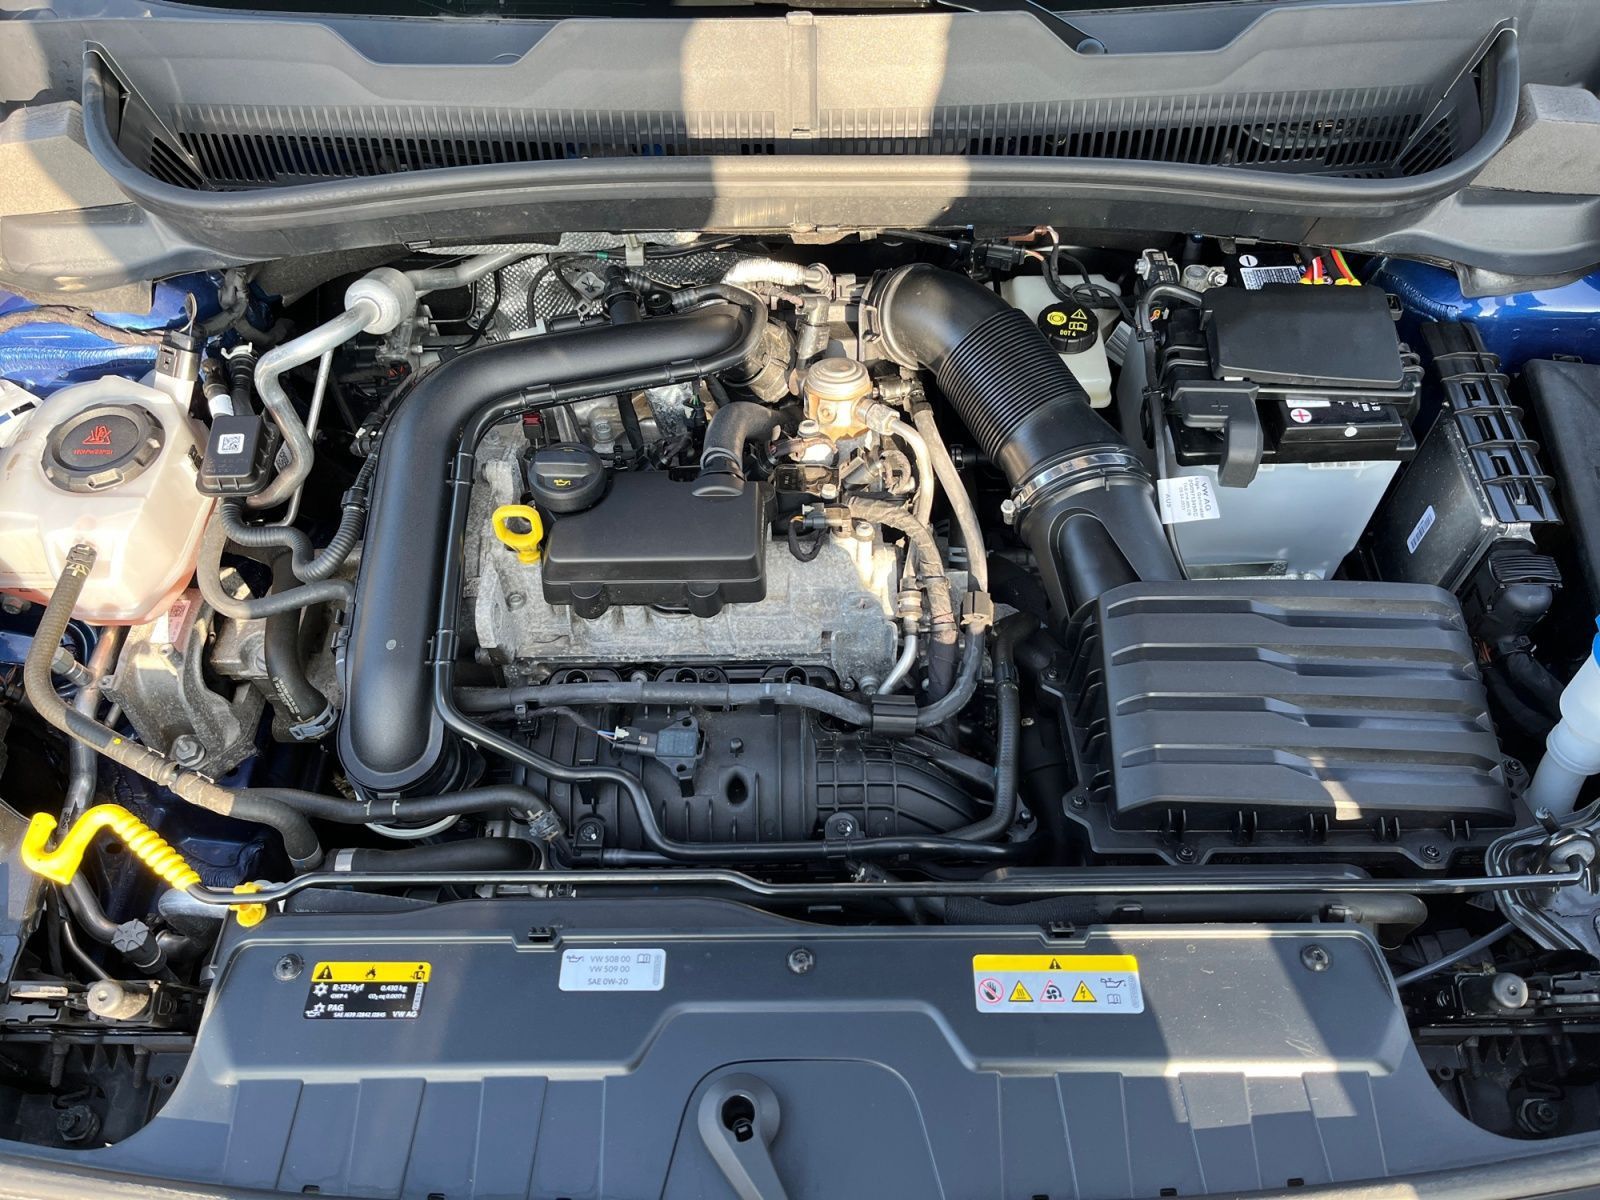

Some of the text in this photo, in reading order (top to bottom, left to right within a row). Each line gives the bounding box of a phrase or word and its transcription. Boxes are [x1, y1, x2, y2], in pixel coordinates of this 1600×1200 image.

[1201, 482, 1212, 511] VW AG
[604, 955, 619, 963] 508
[620, 955, 631, 963] 00
[332, 984, 365, 993] R-1234yf
